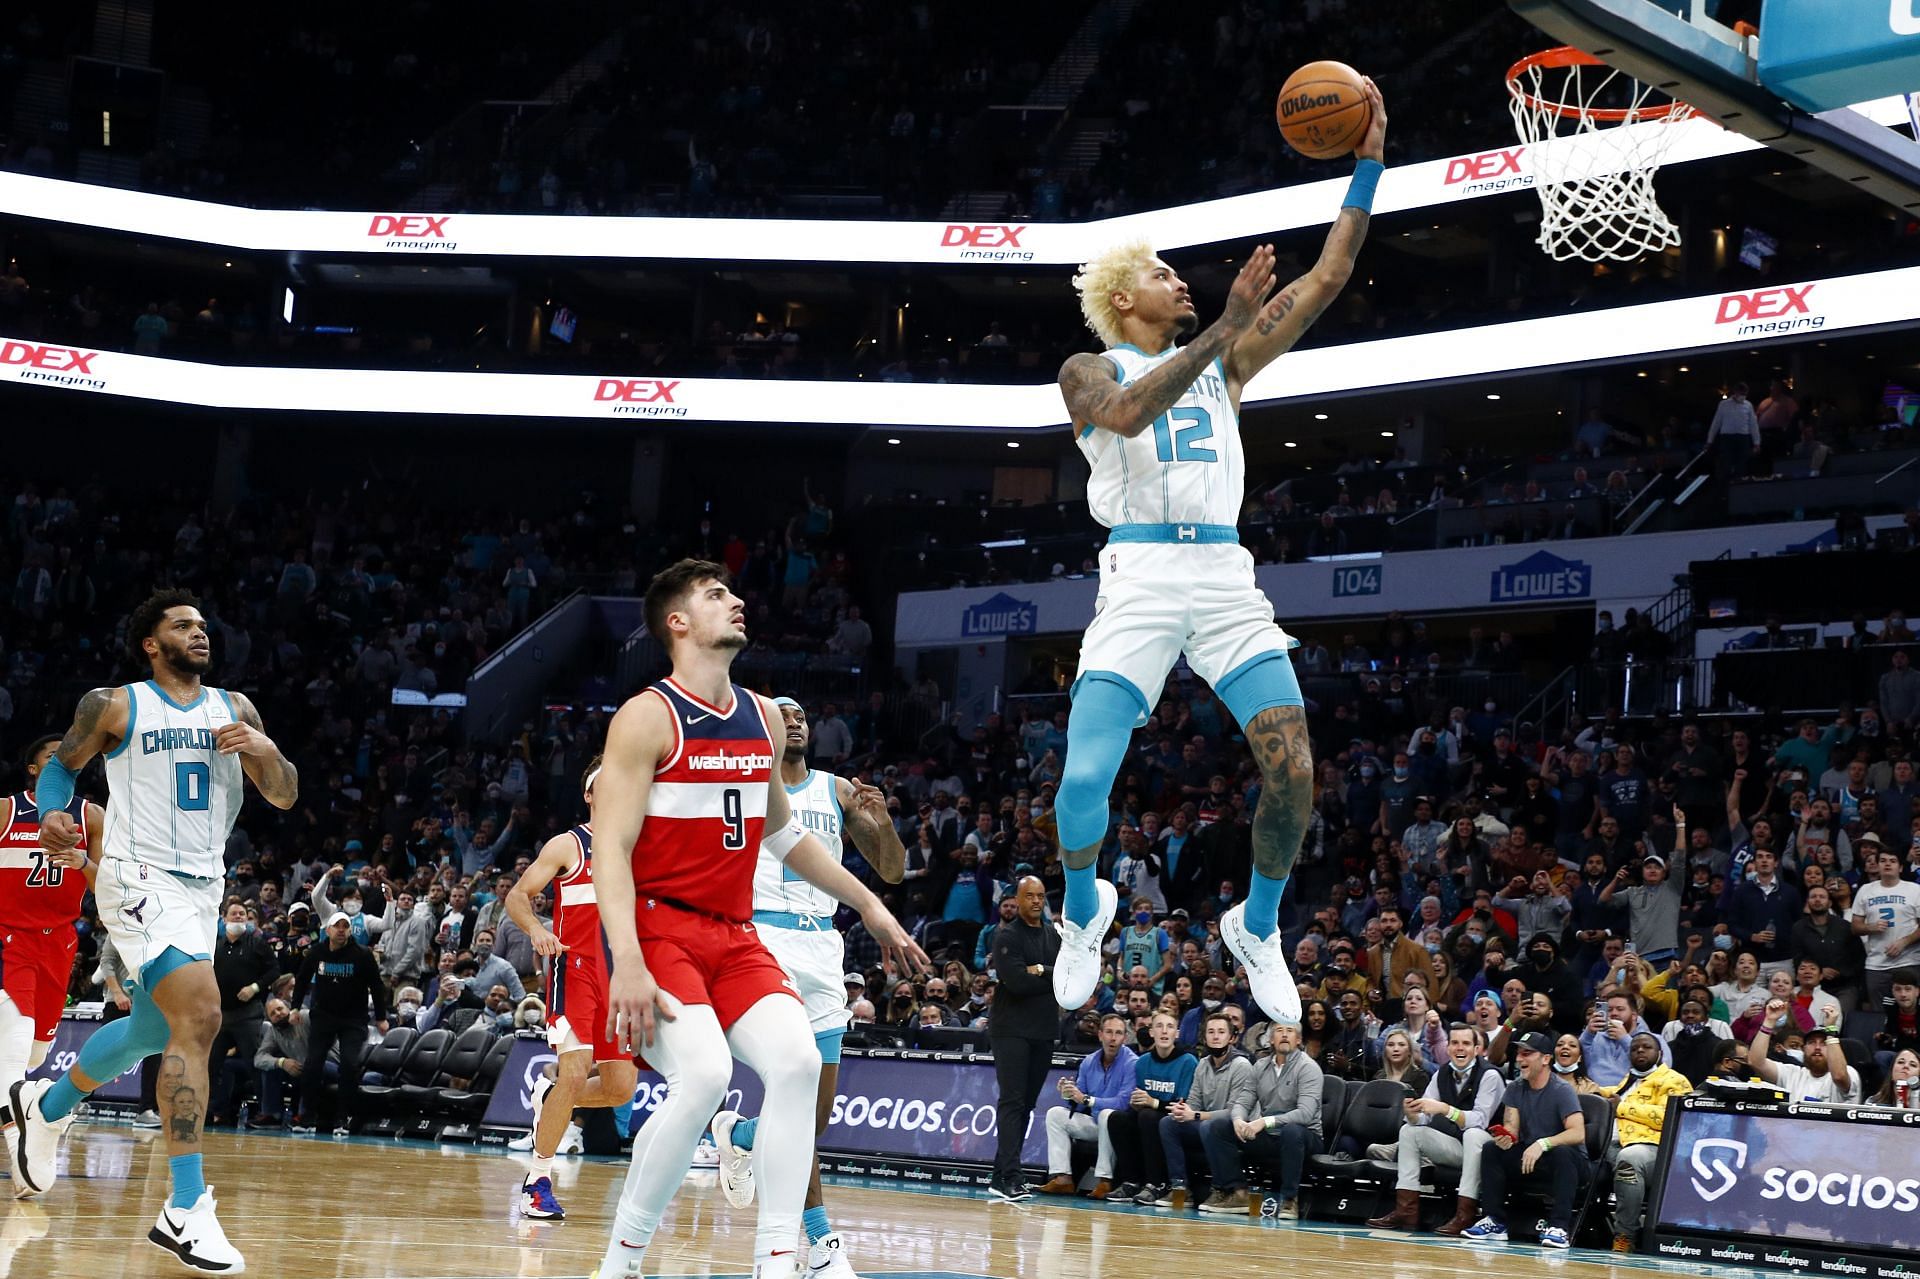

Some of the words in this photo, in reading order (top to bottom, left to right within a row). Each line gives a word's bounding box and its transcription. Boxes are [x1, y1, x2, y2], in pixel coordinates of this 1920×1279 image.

[1281, 93, 1340, 118] Wilson
[1444, 148, 1525, 185] DEX
[1463, 175, 1534, 194] imaging
[368, 216, 450, 237] DEX
[941, 225, 1026, 247] DEX
[387, 239, 457, 250] imaging
[960, 249, 1034, 261] imaging
[1256, 291, 1295, 336] GOD
[1715, 284, 1816, 324] DEX
[1738, 316, 1825, 335] imaging
[0, 342, 99, 374] DEX
[20, 369, 106, 389] imaging
[594, 380, 681, 402] DEX
[613, 403, 687, 416] imaging
[1153, 407, 1218, 462] 12
[1337, 569, 1377, 593] 104
[1500, 569, 1583, 598] LOWE'S
[968, 608, 1031, 633] LOWE'S
[688, 749, 772, 776] washington
[175, 762, 210, 811] 0
[723, 789, 746, 850] 9
[26, 851, 64, 887] 26
[1879, 908, 1895, 927] 2
[1132, 952, 1143, 966] 3
[1745, 1103, 1778, 1111] GATORADE
[1857, 1112, 1893, 1120] GATORADE
[1760, 1167, 1920, 1212] SOCIOS
[1338, 1199, 1348, 1210] 5
[1660, 1243, 1701, 1256] lendingtree
[1711, 1248, 1754, 1261] lendingtree
[1765, 1252, 1809, 1266] lendingtree
[1821, 1260, 1867, 1274] lendingtree
